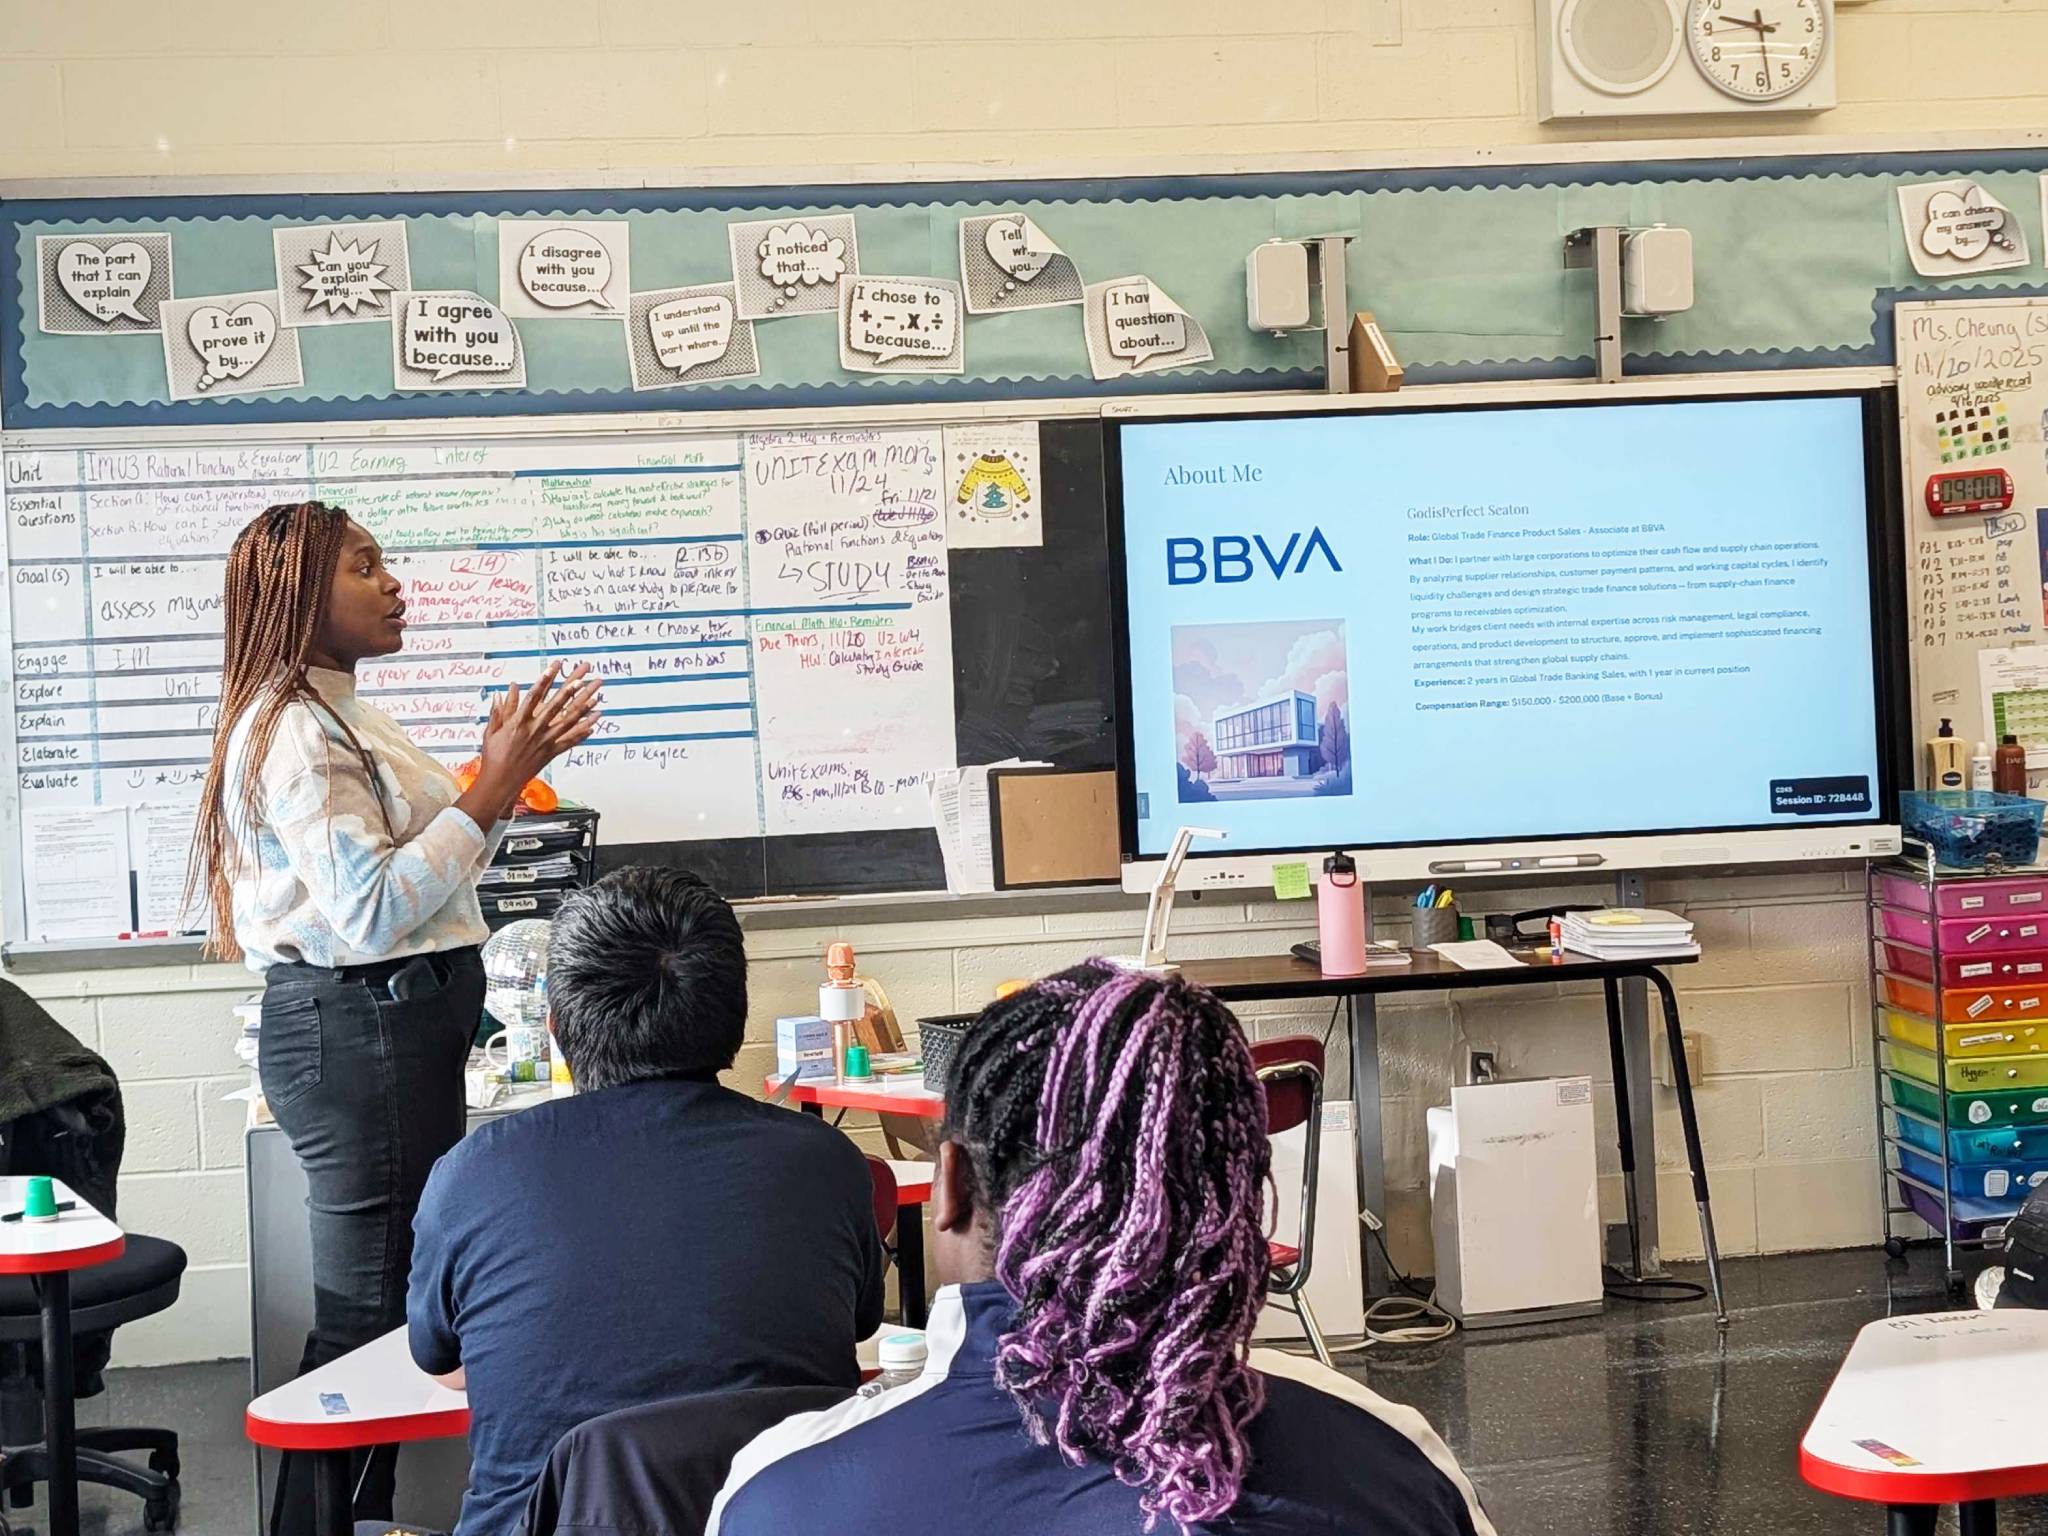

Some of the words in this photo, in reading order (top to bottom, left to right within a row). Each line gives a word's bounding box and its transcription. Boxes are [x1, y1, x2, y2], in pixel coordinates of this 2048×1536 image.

[1703, 22, 1713, 36] 9
[1805, 17, 1815, 32] 3
[1712, 47, 1721, 62] 8
[1800, 46, 1808, 60] 4
[1731, 64, 1740, 80] 7
[1781, 63, 1790, 78] 5
[1756, 72, 1765, 87] 6
[1933, 210, 1938, 220] I
[1942, 210, 1961, 219] can
[1936, 225, 1952, 235] my
[1955, 219, 1994, 231] answer
[1000, 229, 1022, 242] Tell
[529, 246, 537, 258] I
[542, 246, 602, 262] disagree
[763, 244, 771, 257] I
[777, 241, 828, 256] noticed
[76, 253, 100, 266] The
[105, 252, 136, 269] part
[317, 260, 342, 272] Can
[348, 261, 370, 273] you
[776, 260, 820, 274] that...
[72, 270, 100, 282] that
[105, 270, 112, 281] I
[118, 271, 141, 281] can
[536, 264, 565, 276] with
[571, 266, 595, 278] you
[321, 273, 368, 288] explain
[531, 281, 601, 293] because...
[83, 286, 131, 300] explain
[324, 286, 363, 299] why...
[857, 285, 865, 300] I
[872, 289, 917, 304] chose
[924, 291, 940, 305] to
[1112, 292, 1119, 306] I
[1125, 292, 1150, 305] hav
[96, 304, 119, 315] is...
[418, 300, 428, 317] I
[438, 305, 493, 324] agree
[654, 312, 660, 322] I
[664, 303, 721, 320] understand
[211, 316, 219, 329] I
[226, 314, 253, 328] can
[1115, 312, 1175, 330] question
[415, 328, 457, 343] with
[466, 331, 499, 348] you
[661, 328, 675, 341] up
[678, 324, 701, 336] until
[703, 320, 720, 332] the
[203, 336, 248, 352] prove
[254, 331, 266, 345] it
[660, 343, 683, 357] part
[688, 339, 729, 352] where...
[864, 330, 947, 351] because...
[1119, 334, 1175, 350] about...
[219, 355, 254, 370] by...
[413, 349, 512, 367] because...
[10, 460, 43, 484] Unit
[1164, 466, 1226, 485] About
[1232, 464, 1263, 483] Me
[10, 496, 62, 512] Essential
[1407, 505, 1484, 519] GodisPerfect
[1488, 504, 1529, 516] Seaton
[18, 512, 76, 527] Questions
[1408, 534, 1429, 542] Role:
[1432, 532, 1459, 541] Global
[1462, 531, 1484, 539] Trade
[1488, 530, 1520, 538] Finance
[1522, 529, 1555, 537] Product
[1641, 524, 1665, 532] BBVA
[563, 549, 582, 562] will
[1166, 525, 1343, 585] BBVA
[807, 561, 890, 592] STUDY
[1411, 612, 1452, 620] programs
[1464, 609, 1512, 617] receivables
[1514, 606, 1567, 615] optimization.
[760, 636, 781, 652] Due
[1413, 661, 1472, 669] arrangements
[1494, 657, 1539, 666] strengthen
[1542, 656, 1568, 664] global
[1571, 654, 1598, 663] supply
[1414, 679, 1466, 687] Experience:
[1475, 678, 1498, 686] years
[1510, 674, 1537, 683] Global
[1540, 673, 1563, 681] Trade
[1566, 672, 1599, 681] Banking
[1655, 669, 1672, 678] year
[1685, 667, 1714, 675] current
[1717, 665, 1750, 674] position
[1416, 701, 1477, 711] Compensation
[1480, 699, 1510, 709] Range:
[1512, 696, 1551, 706] $150,000
[1559, 695, 1599, 704] $200,000
[1634, 693, 1663, 701] Bonus)
[1776, 794, 1813, 806] Session
[1814, 795, 1826, 804] ID:
[1828, 792, 1865, 803] 728448
